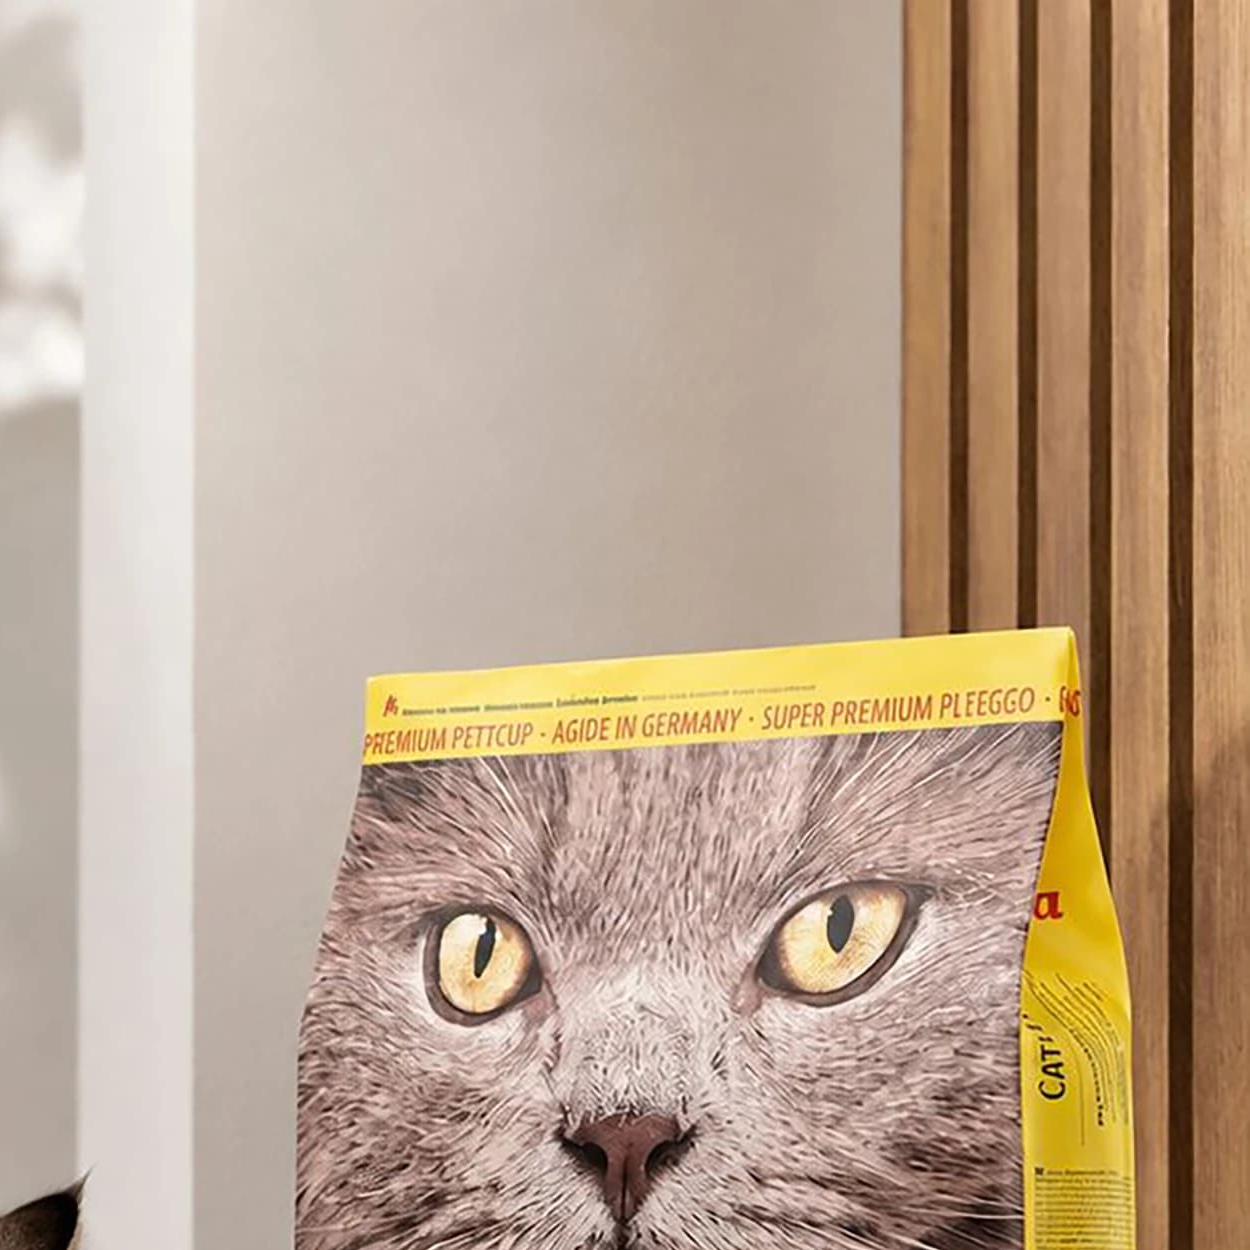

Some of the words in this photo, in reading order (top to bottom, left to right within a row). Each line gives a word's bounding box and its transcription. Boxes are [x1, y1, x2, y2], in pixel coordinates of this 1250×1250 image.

[362, 727, 447, 756] PREMIUM
[452, 722, 533, 749] PETTCUP
[552, 717, 611, 744] AGIDE
[615, 714, 637, 740] IN
[641, 706, 743, 738] GERMANY
[761, 701, 824, 731] SUPER
[830, 694, 933, 726] PREMIUM
[939, 686, 1036, 720] PLEEGGO
